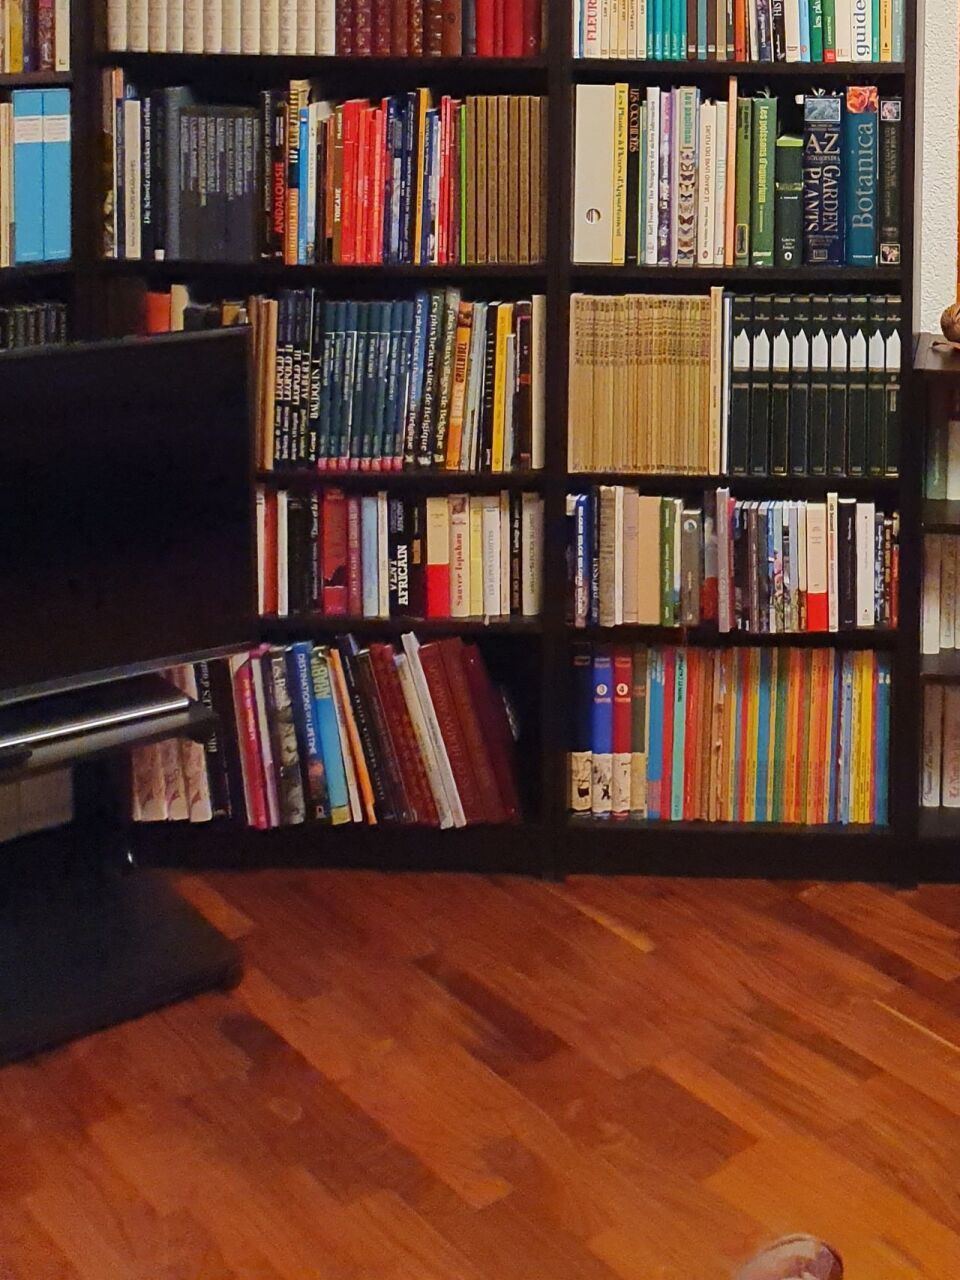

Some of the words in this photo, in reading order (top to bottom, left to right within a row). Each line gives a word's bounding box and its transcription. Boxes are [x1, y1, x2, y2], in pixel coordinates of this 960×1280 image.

[813, 16, 822, 27] les
[853, 0, 870, 56] guide
[143, 98, 151, 125] erleben
[683, 92, 693, 105] Les
[760, 106, 768, 119] Les
[143, 126, 151, 140] und
[617, 107, 625, 138] Plantes
[758, 120, 768, 157] poissons
[758, 158, 768, 203] d'aquarium
[851, 122, 874, 229] Botanica
[274, 162, 284, 233] ANDALOUSIE
[804, 167, 821, 231] PLANTS
[822, 165, 841, 232] GARDEN
[143, 210, 151, 223] Die
[416, 299, 424, 312] Les
[432, 295, 440, 312] Les
[414, 313, 422, 329] plus
[429, 314, 438, 335] plus
[447, 310, 455, 330] plus
[428, 337, 437, 367] beaux
[444, 331, 453, 360] beaux
[442, 361, 452, 395] villages
[455, 342, 467, 383] GRILLBIBEL
[301, 361, 309, 399] ALBERT
[310, 369, 320, 419] BAUDOUIN
[426, 369, 435, 391] sites
[409, 401, 417, 411] de
[425, 393, 433, 405] de
[440, 396, 448, 407] de
[407, 412, 416, 449] Belgique
[421, 407, 431, 451] Belgique
[437, 408, 447, 449] Belgique
[454, 533, 464, 570] Ispahan
[397, 545, 408, 605] AFRICAIN
[454, 573, 463, 606] Sauver
[297, 653, 311, 711] DESTINATIONS
[306, 723, 317, 755] LIFETIME
[619, 686, 625, 694] 4
